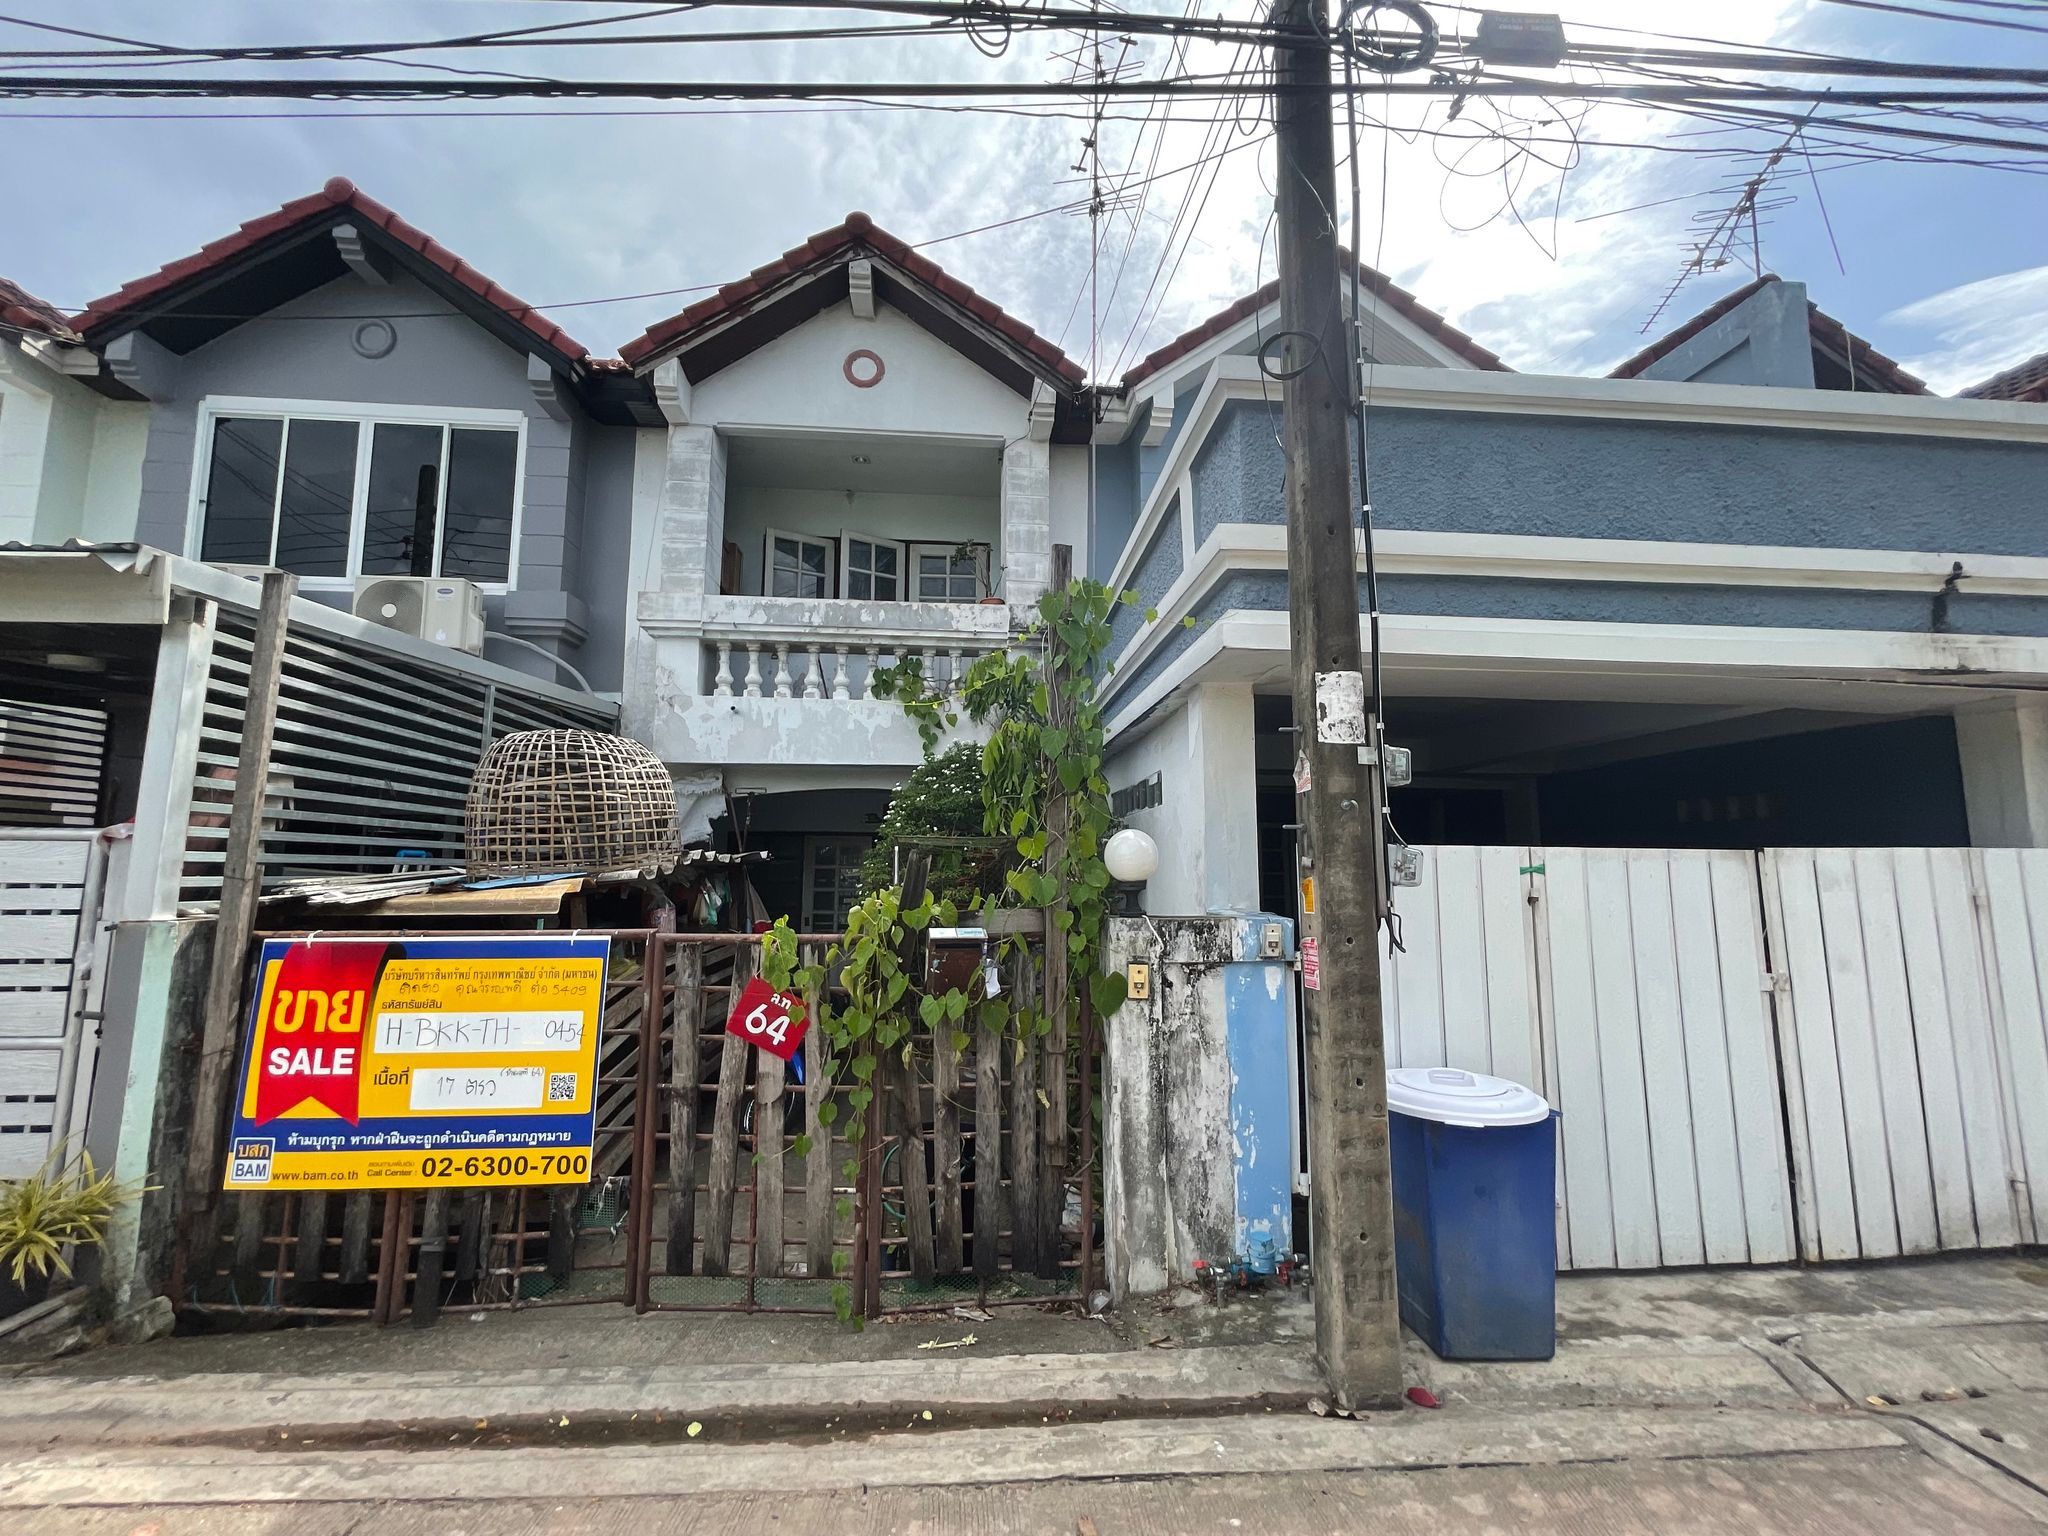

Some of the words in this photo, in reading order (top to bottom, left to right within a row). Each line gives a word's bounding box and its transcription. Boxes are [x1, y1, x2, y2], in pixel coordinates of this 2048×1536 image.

[384, 967, 471, 981] บริษัทบริหารสินทรัพย์
[473, 967, 537, 983] กรุงเทพพาณิชย์
[538, 967, 560, 980] จำกัด
[563, 968, 598, 982] (มหาชน)
[552, 984, 587, 997] 5409
[274, 990, 365, 1033] ขาย
[382, 998, 442, 1010] รหัสทรัพย์สิน
[745, 1003, 791, 1046] 64
[268, 1047, 355, 1075] SALE
[374, 1066, 410, 1085] เนื้อที่
[437, 1076, 455, 1096] 17
[288, 1132, 346, 1150] ห้ามบุกรุก
[238, 1143, 269, 1158] บสก
[235, 1163, 267, 1177] BAM
[367, 1169, 382, 1177] Call
[421, 1155, 588, 1178] 02-6300-700
[272, 1171, 359, 1181] www.bam.co.th
